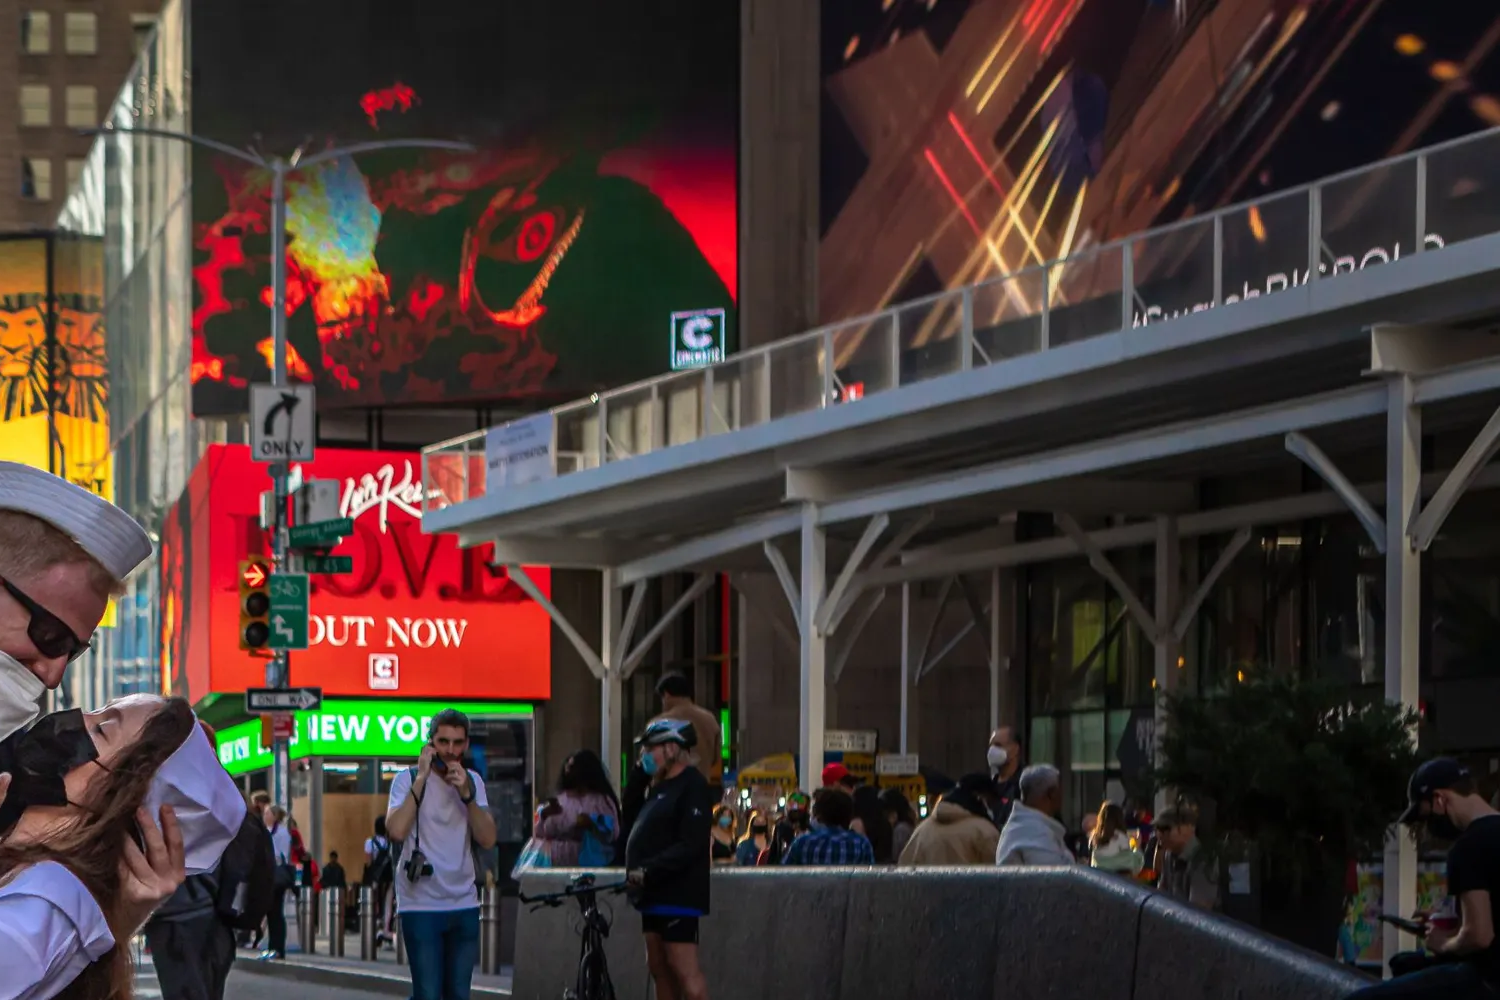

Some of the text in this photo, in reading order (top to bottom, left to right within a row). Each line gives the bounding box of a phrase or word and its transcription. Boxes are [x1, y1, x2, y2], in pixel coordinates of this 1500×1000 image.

[681, 315, 714, 351] C
[261, 440, 304, 456] ONLY
[308, 614, 468, 649] OUT NOW
[373, 658, 393, 679] C
[257, 694, 312, 705] ONE WAY
[309, 714, 370, 742] NEW
